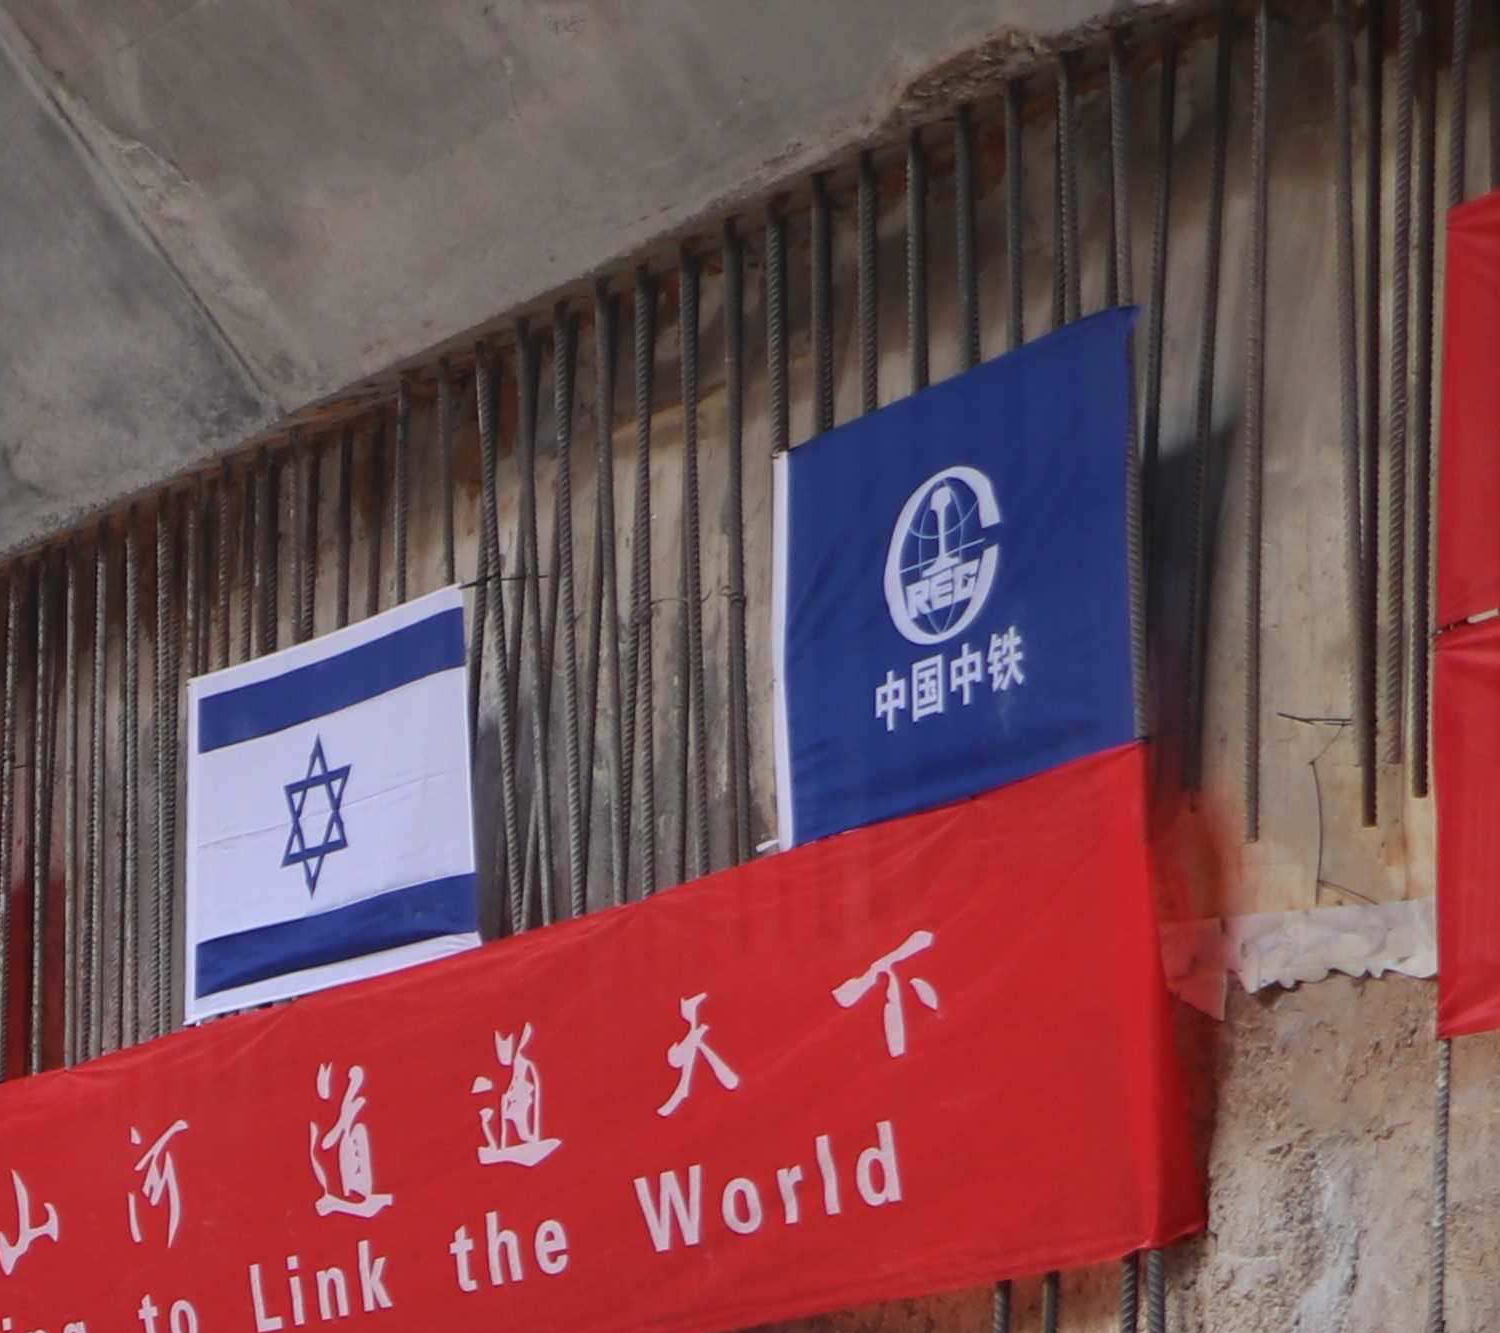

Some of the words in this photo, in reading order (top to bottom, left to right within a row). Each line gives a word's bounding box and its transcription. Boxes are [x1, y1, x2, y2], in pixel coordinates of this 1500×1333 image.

[875, 626, 1026, 731] 中国中铁
[449, 1212, 569, 1293] the
[634, 1120, 903, 1253] World
